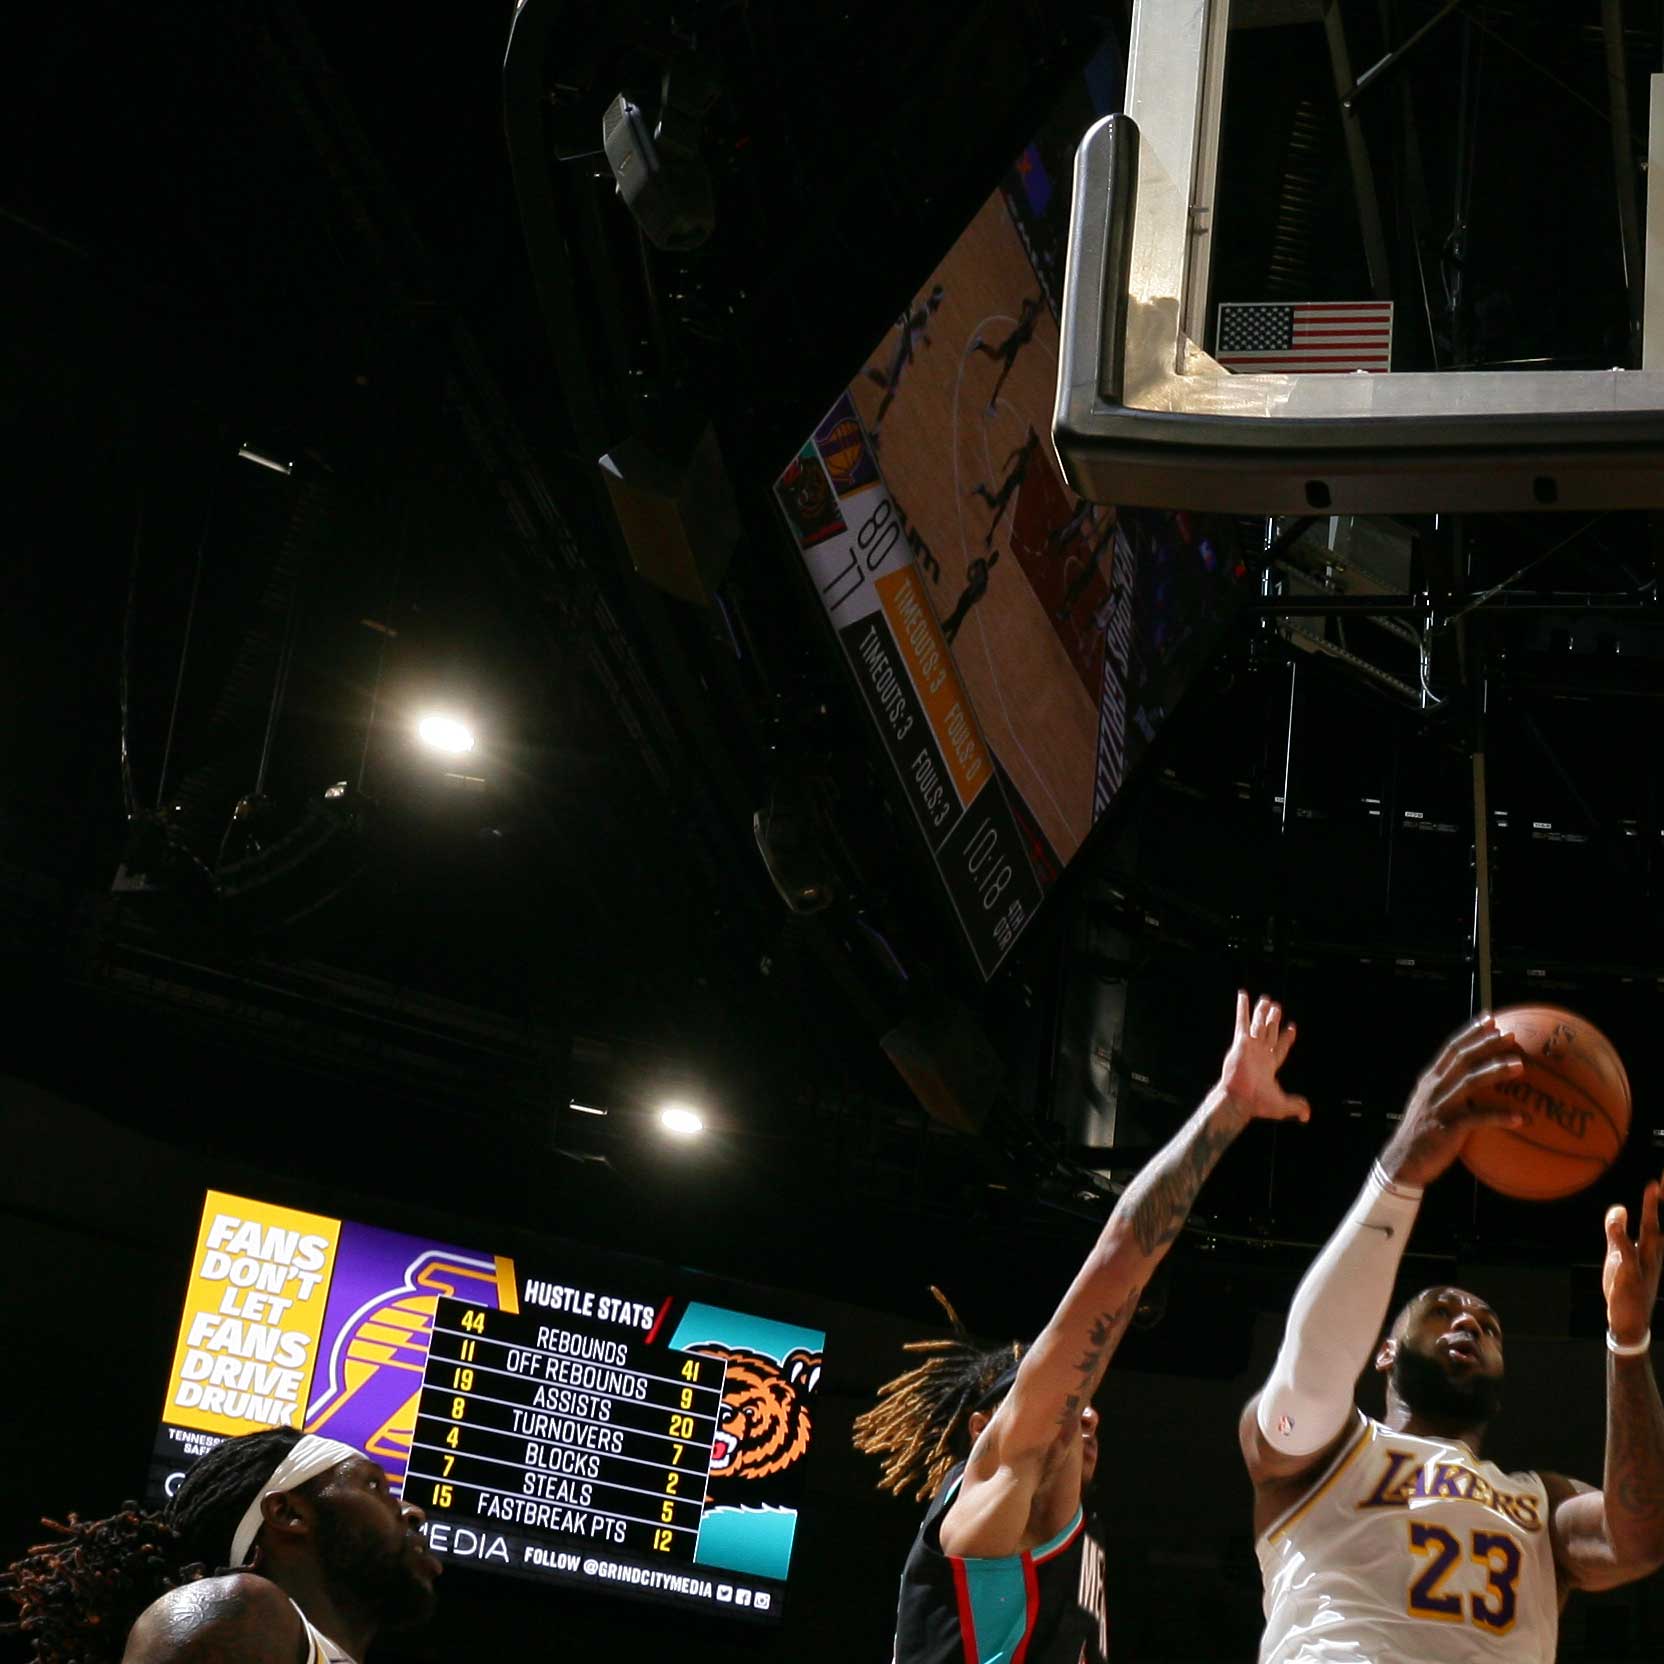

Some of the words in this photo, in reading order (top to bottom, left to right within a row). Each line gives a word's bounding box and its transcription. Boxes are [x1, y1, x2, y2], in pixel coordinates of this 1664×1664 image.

[858, 500, 899, 571] 80
[823, 547, 865, 612] 77
[962, 817, 1012, 910] 10:18
[200, 1249, 323, 1301] DON'T
[206, 1214, 329, 1272] FANS
[219, 1286, 293, 1326] LET
[524, 1279, 597, 1316] HUSTLE
[597, 1296, 655, 1330] STATS
[186, 1311, 312, 1368] FANS
[461, 1310, 486, 1334] 44
[537, 1326, 628, 1366] REBOUNDS
[681, 1360, 700, 1382] 41
[175, 1383, 298, 1427] DRUNK
[180, 1349, 304, 1401] DRIVE
[453, 1367, 474, 1392] 19
[532, 1385, 612, 1422] ASSISTS
[668, 1414, 694, 1439] 20
[460, 1339, 476, 1361] 11
[506, 1349, 542, 1376] OFF
[545, 1358, 648, 1400] REBOUNDS
[680, 1388, 693, 1410] 9
[446, 1427, 459, 1448] 4
[525, 1442, 600, 1479] BLOCKS
[666, 1474, 679, 1495] 2
[451, 1397, 465, 1420] 8
[512, 1409, 624, 1453] TURNOVERS
[671, 1443, 684, 1466] 7
[432, 1483, 453, 1508] 15
[476, 1492, 588, 1536] FASTBREAK
[590, 1514, 627, 1543] PTS
[652, 1528, 671, 1553] 12
[442, 1455, 454, 1477] 7
[523, 1472, 592, 1507] STEALS
[661, 1502, 674, 1523] 5
[1355, 1448, 1543, 1533] LAKERS
[524, 1546, 582, 1574] FOLLOW
[582, 1557, 713, 1599] @GRINDCITYMEDIA
[1407, 1519, 1524, 1637] 23
